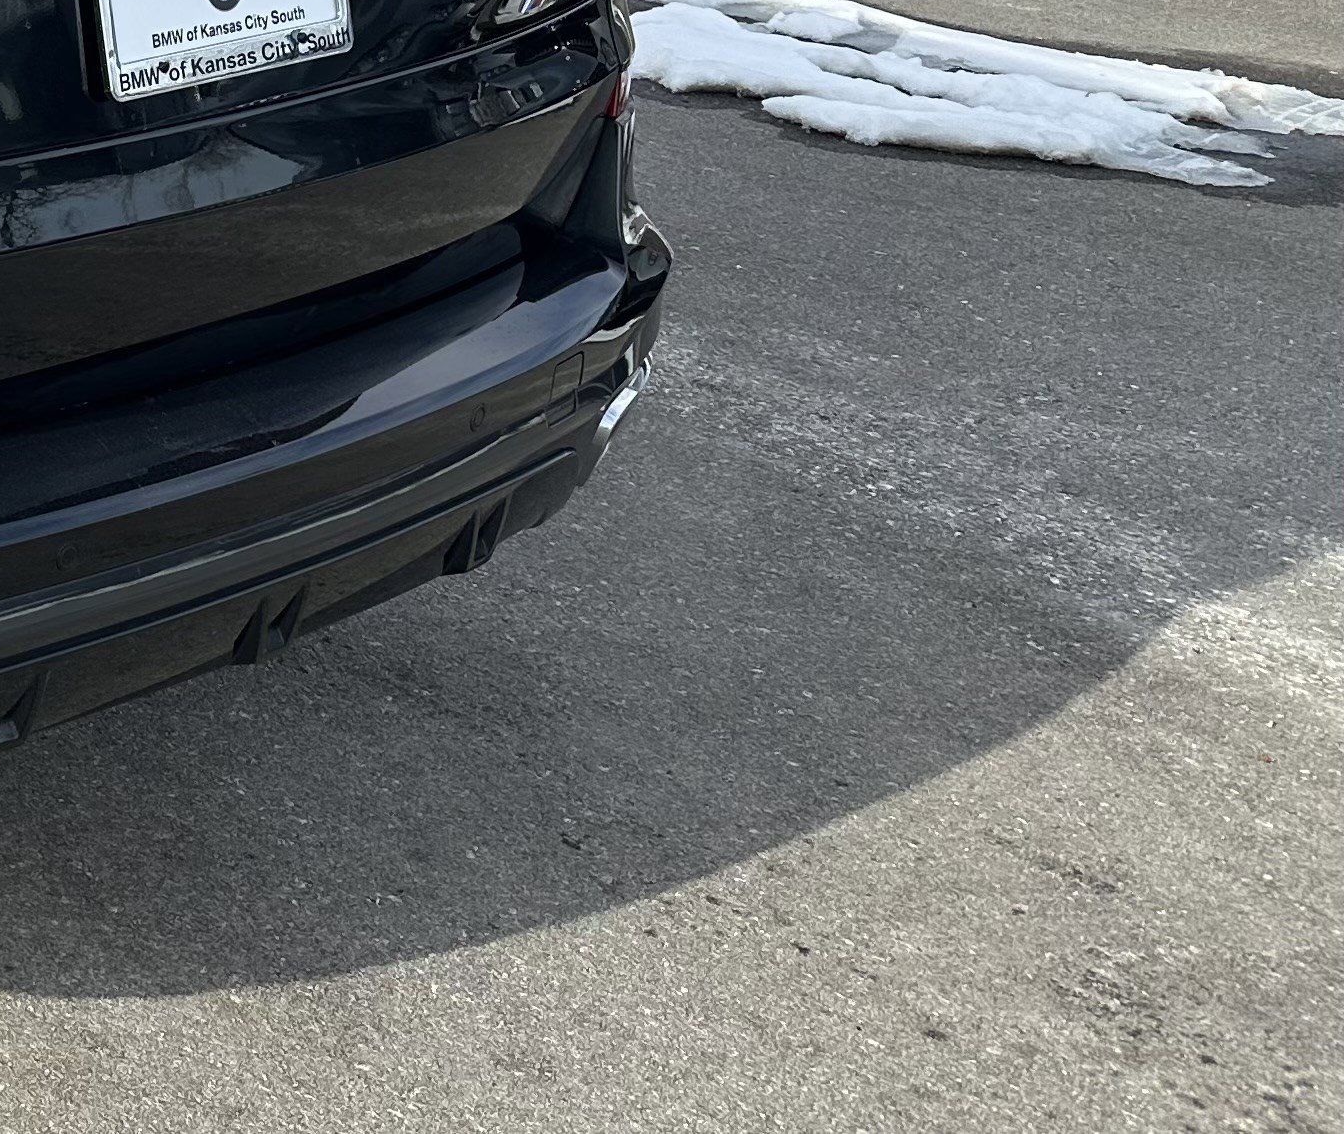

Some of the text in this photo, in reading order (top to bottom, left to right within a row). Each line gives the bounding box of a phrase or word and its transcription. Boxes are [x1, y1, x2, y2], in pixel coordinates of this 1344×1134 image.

[152, 6, 306, 48] BMW of Kansas City South
[120, 26, 351, 92] BMW of Kansas City South
